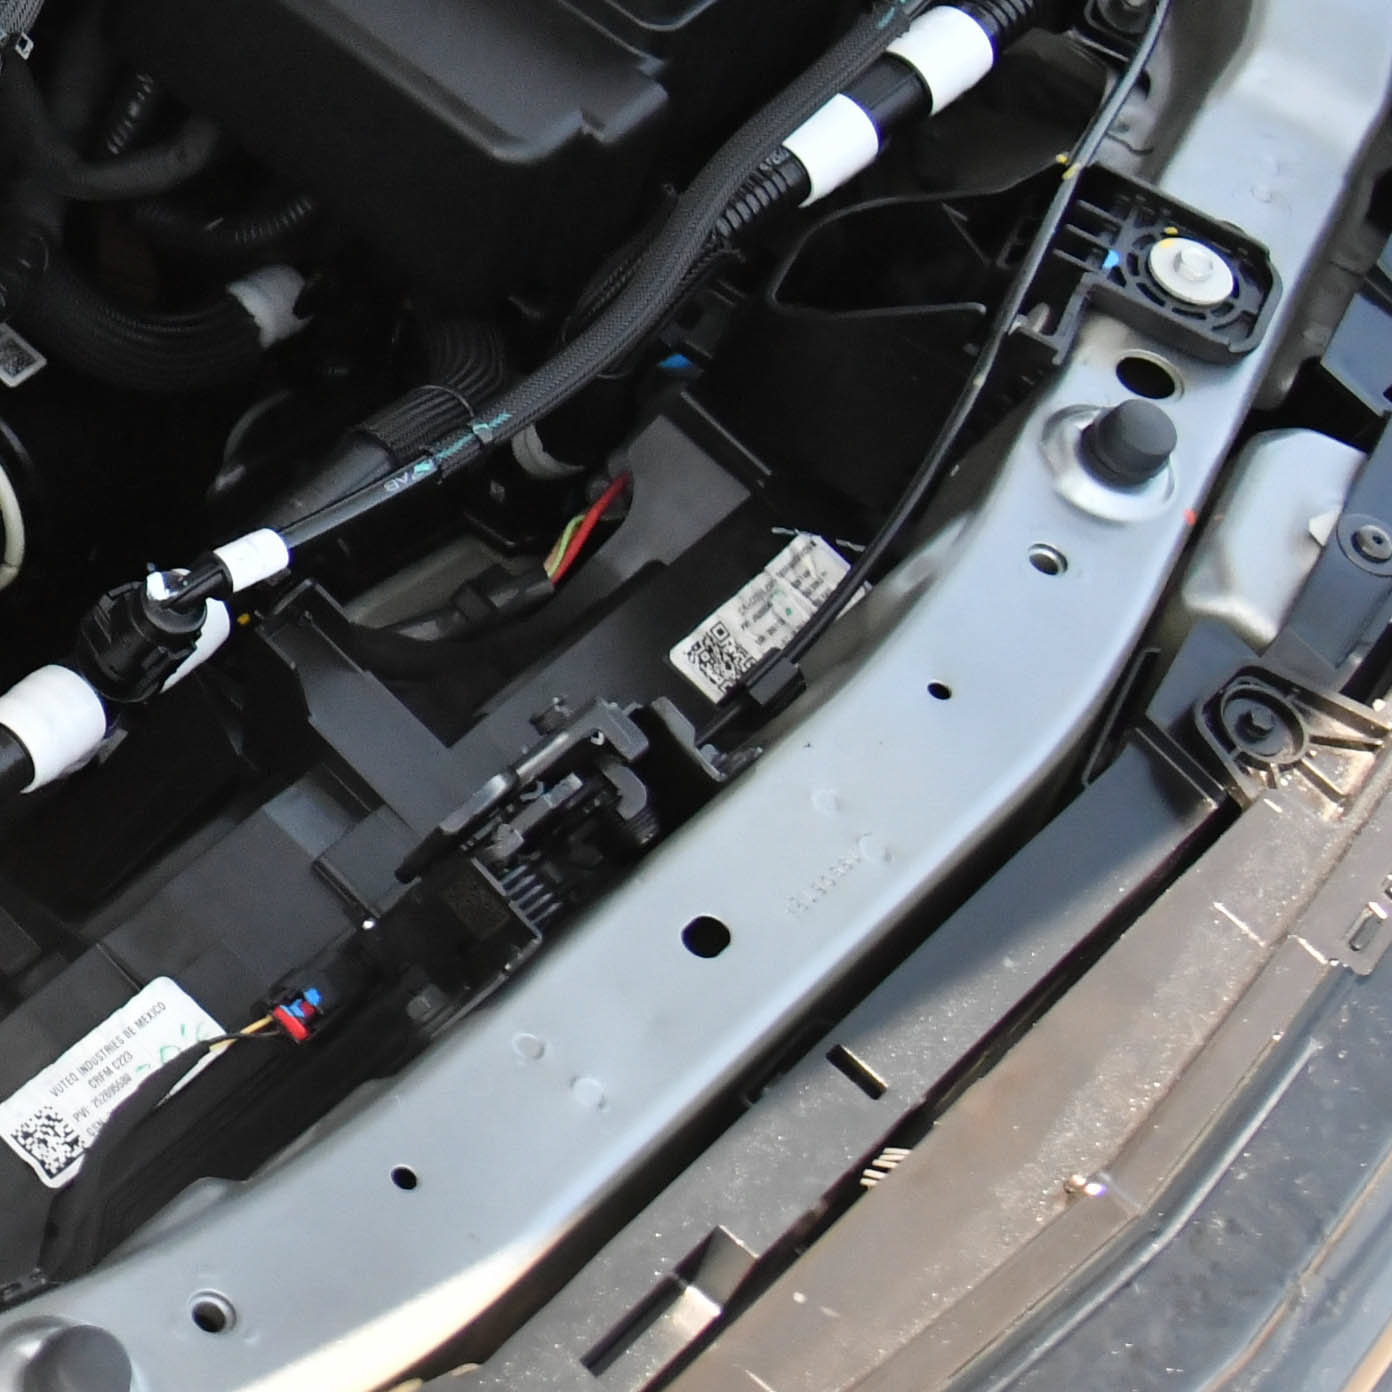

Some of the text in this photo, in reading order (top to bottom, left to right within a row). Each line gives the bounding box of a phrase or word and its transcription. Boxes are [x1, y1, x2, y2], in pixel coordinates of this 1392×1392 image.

[49, 1001, 167, 1098] VUTEQ INDUSTRIES DE MEXICO
[112, 1051, 134, 1070] C223
